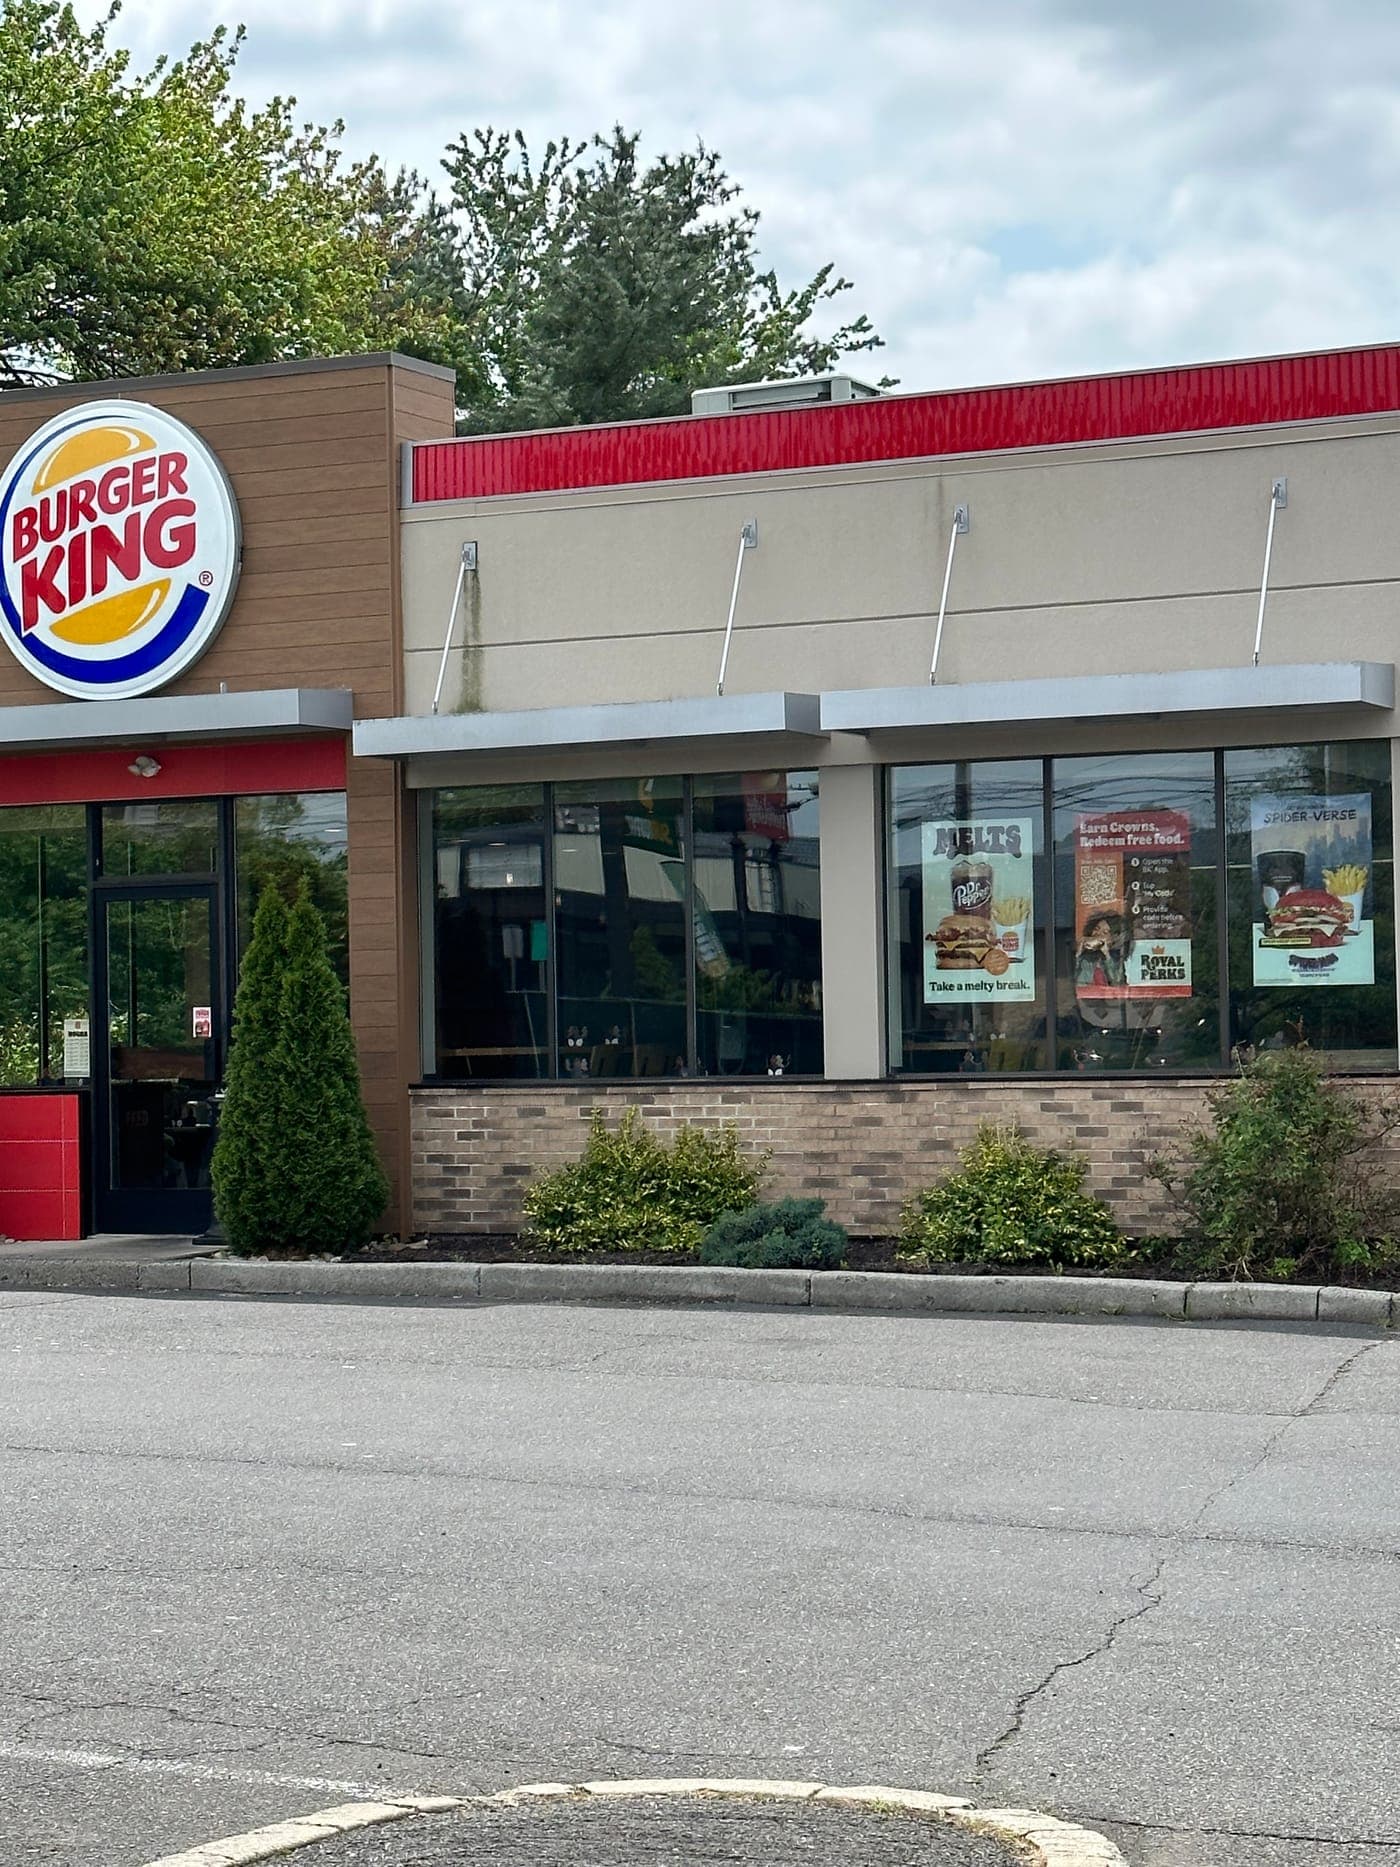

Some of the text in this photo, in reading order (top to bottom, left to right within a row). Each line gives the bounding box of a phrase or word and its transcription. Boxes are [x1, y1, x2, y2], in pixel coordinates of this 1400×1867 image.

[12, 451, 189, 563] BURGER
[20, 498, 198, 632] KING
[1263, 809, 1357, 824] SPIDER-VERSE
[1079, 822, 1160, 834] Earn Crowns.
[933, 824, 1022, 860] MELTS
[1079, 833, 1185, 847] Redeem free food.
[966, 881, 981, 894] Dr
[957, 885, 990, 907] Pepper
[1140, 953, 1185, 971] ROYAL
[1140, 966, 1186, 981] PERKS
[928, 979, 1030, 993] Take a melty break.
